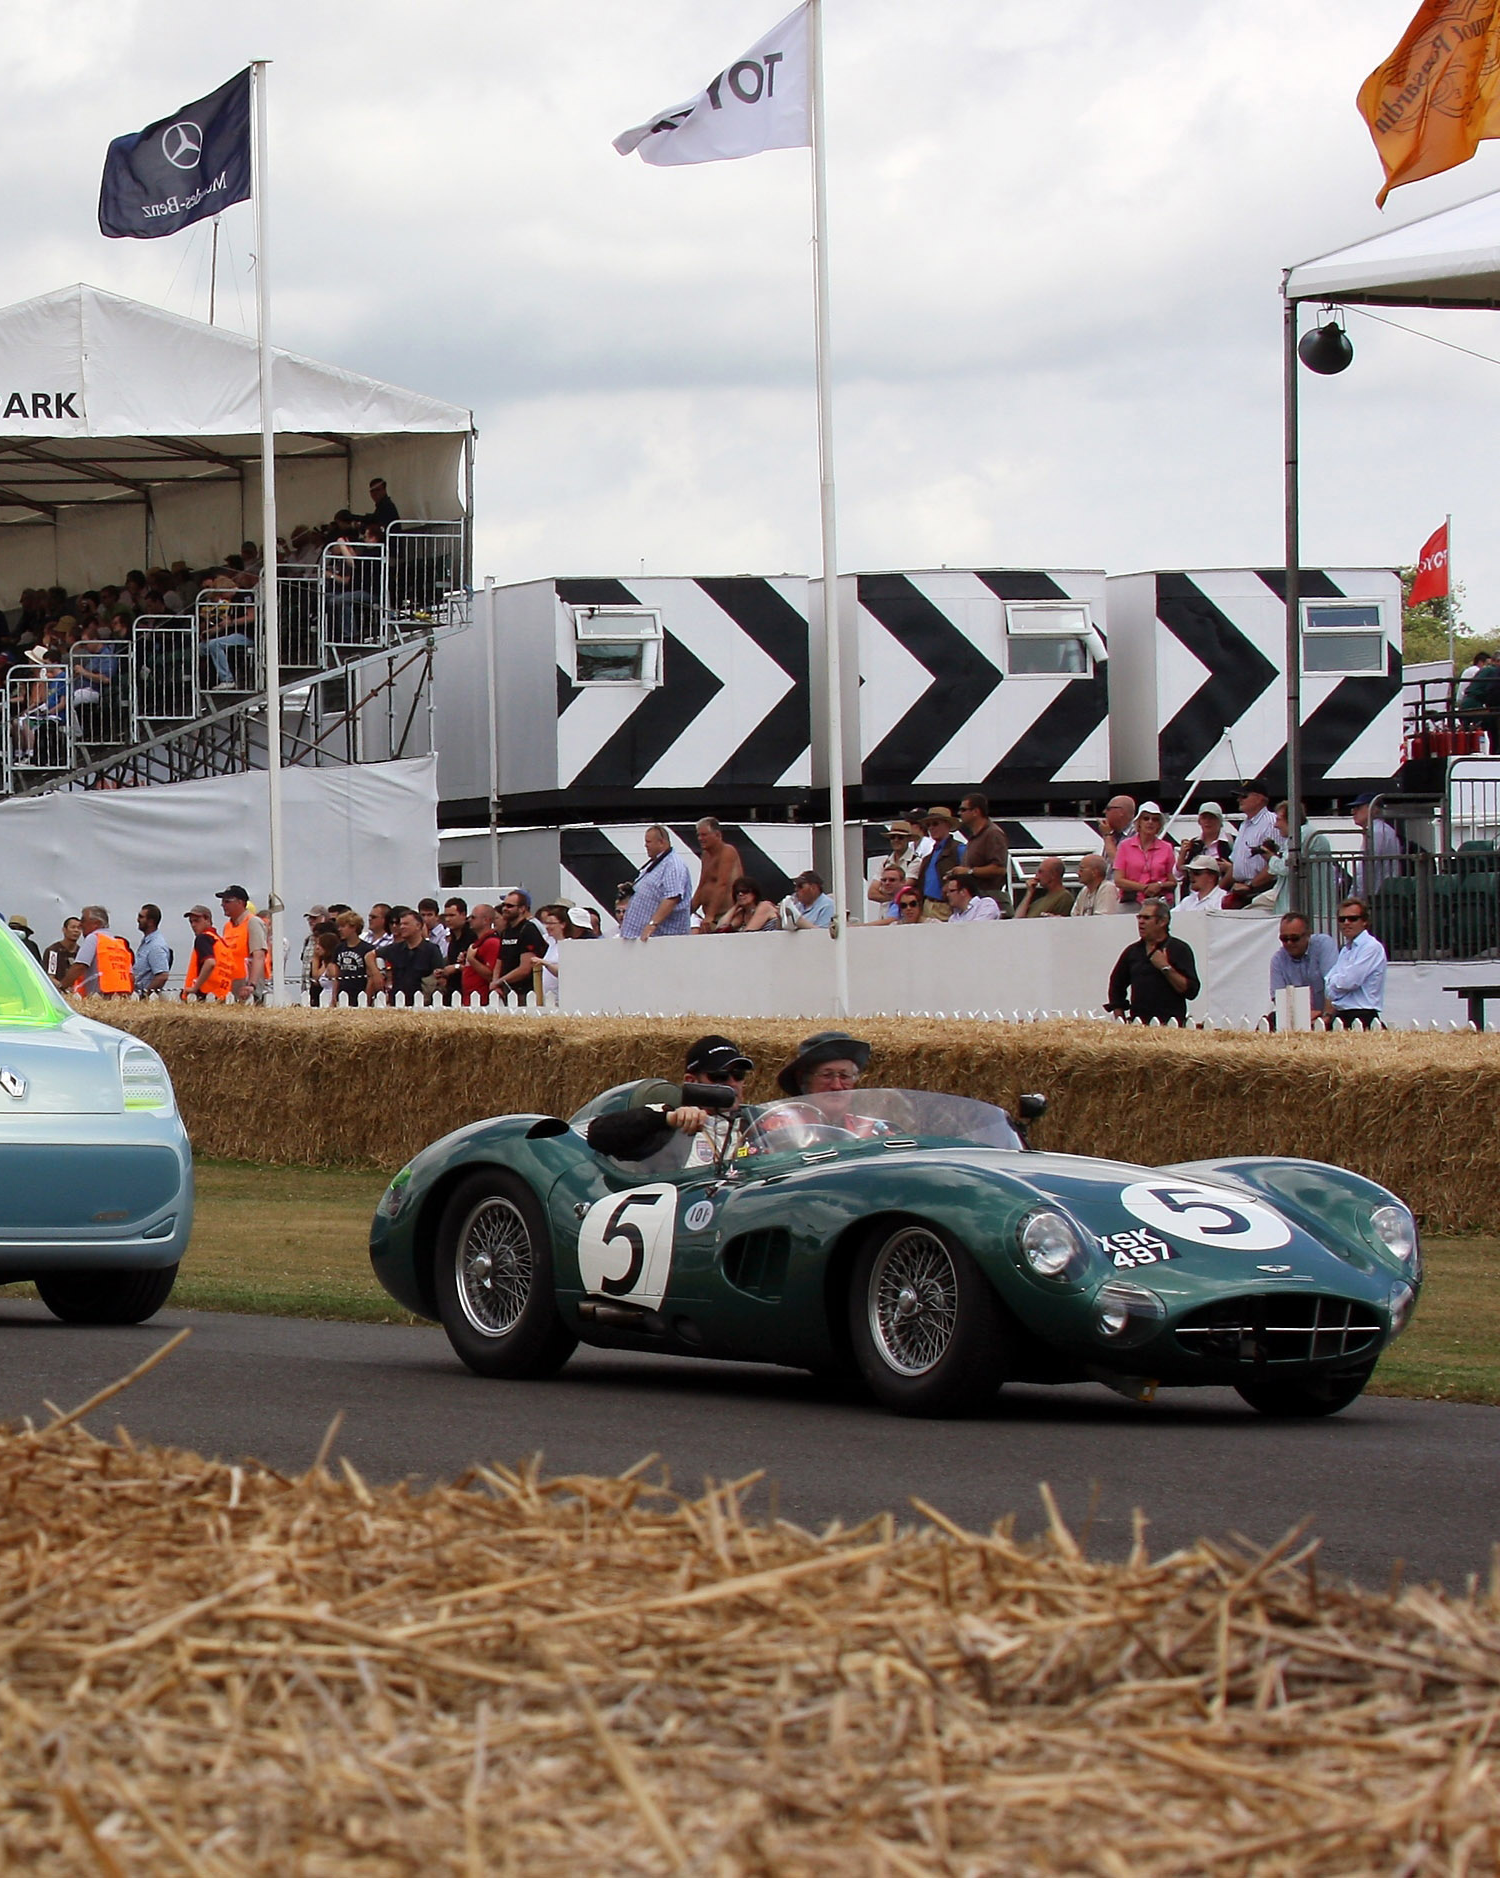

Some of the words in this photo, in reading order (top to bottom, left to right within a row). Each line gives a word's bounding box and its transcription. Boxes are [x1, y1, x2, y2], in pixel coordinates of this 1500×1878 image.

[1147, 1188, 1252, 1235] 5
[601, 1193, 663, 1296] 5
[1094, 1228, 1162, 1252] XSK
[1112, 1242, 1170, 1268] 497
